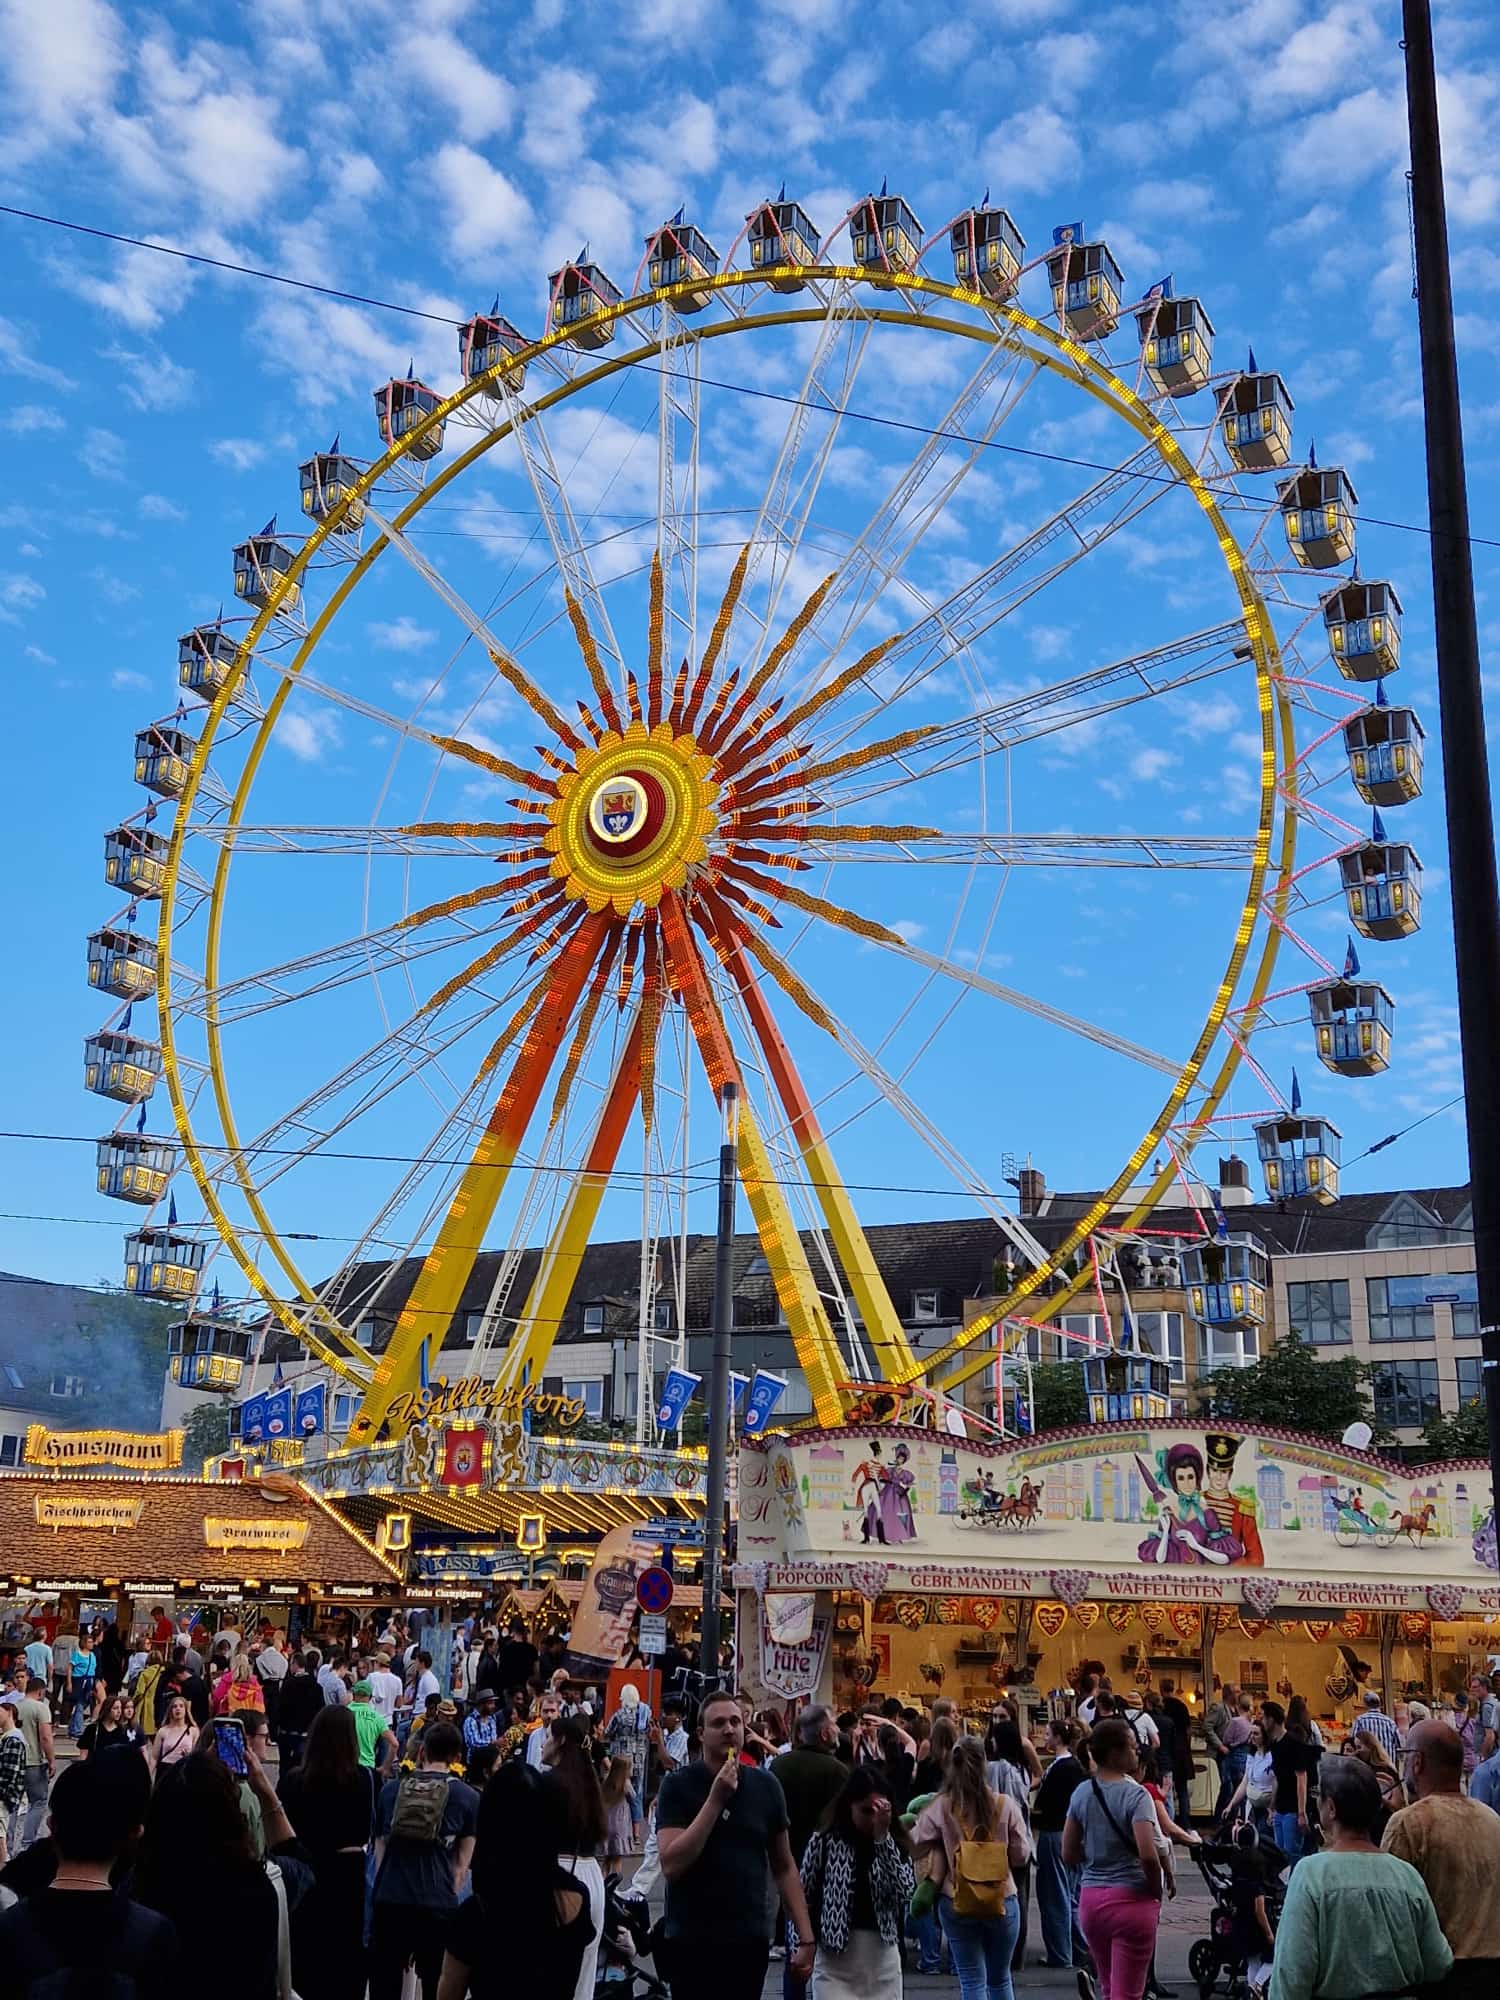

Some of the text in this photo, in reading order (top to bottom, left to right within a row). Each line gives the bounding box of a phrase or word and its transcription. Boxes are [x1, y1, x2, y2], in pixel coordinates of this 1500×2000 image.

[385, 1375, 586, 1427] Willenborg
[44, 1438, 162, 1460] Hausmann
[44, 1504, 132, 1519] Fischbrötchen
[222, 1527, 290, 1539] Bratwurst
[431, 1554, 480, 1571] KASSE
[776, 1571, 845, 1585] POPCORN
[1297, 1590, 1409, 1606] ZUCKERWATTE
[1479, 1595, 1500, 1609] SC
[774, 1650, 810, 1672] tüte
